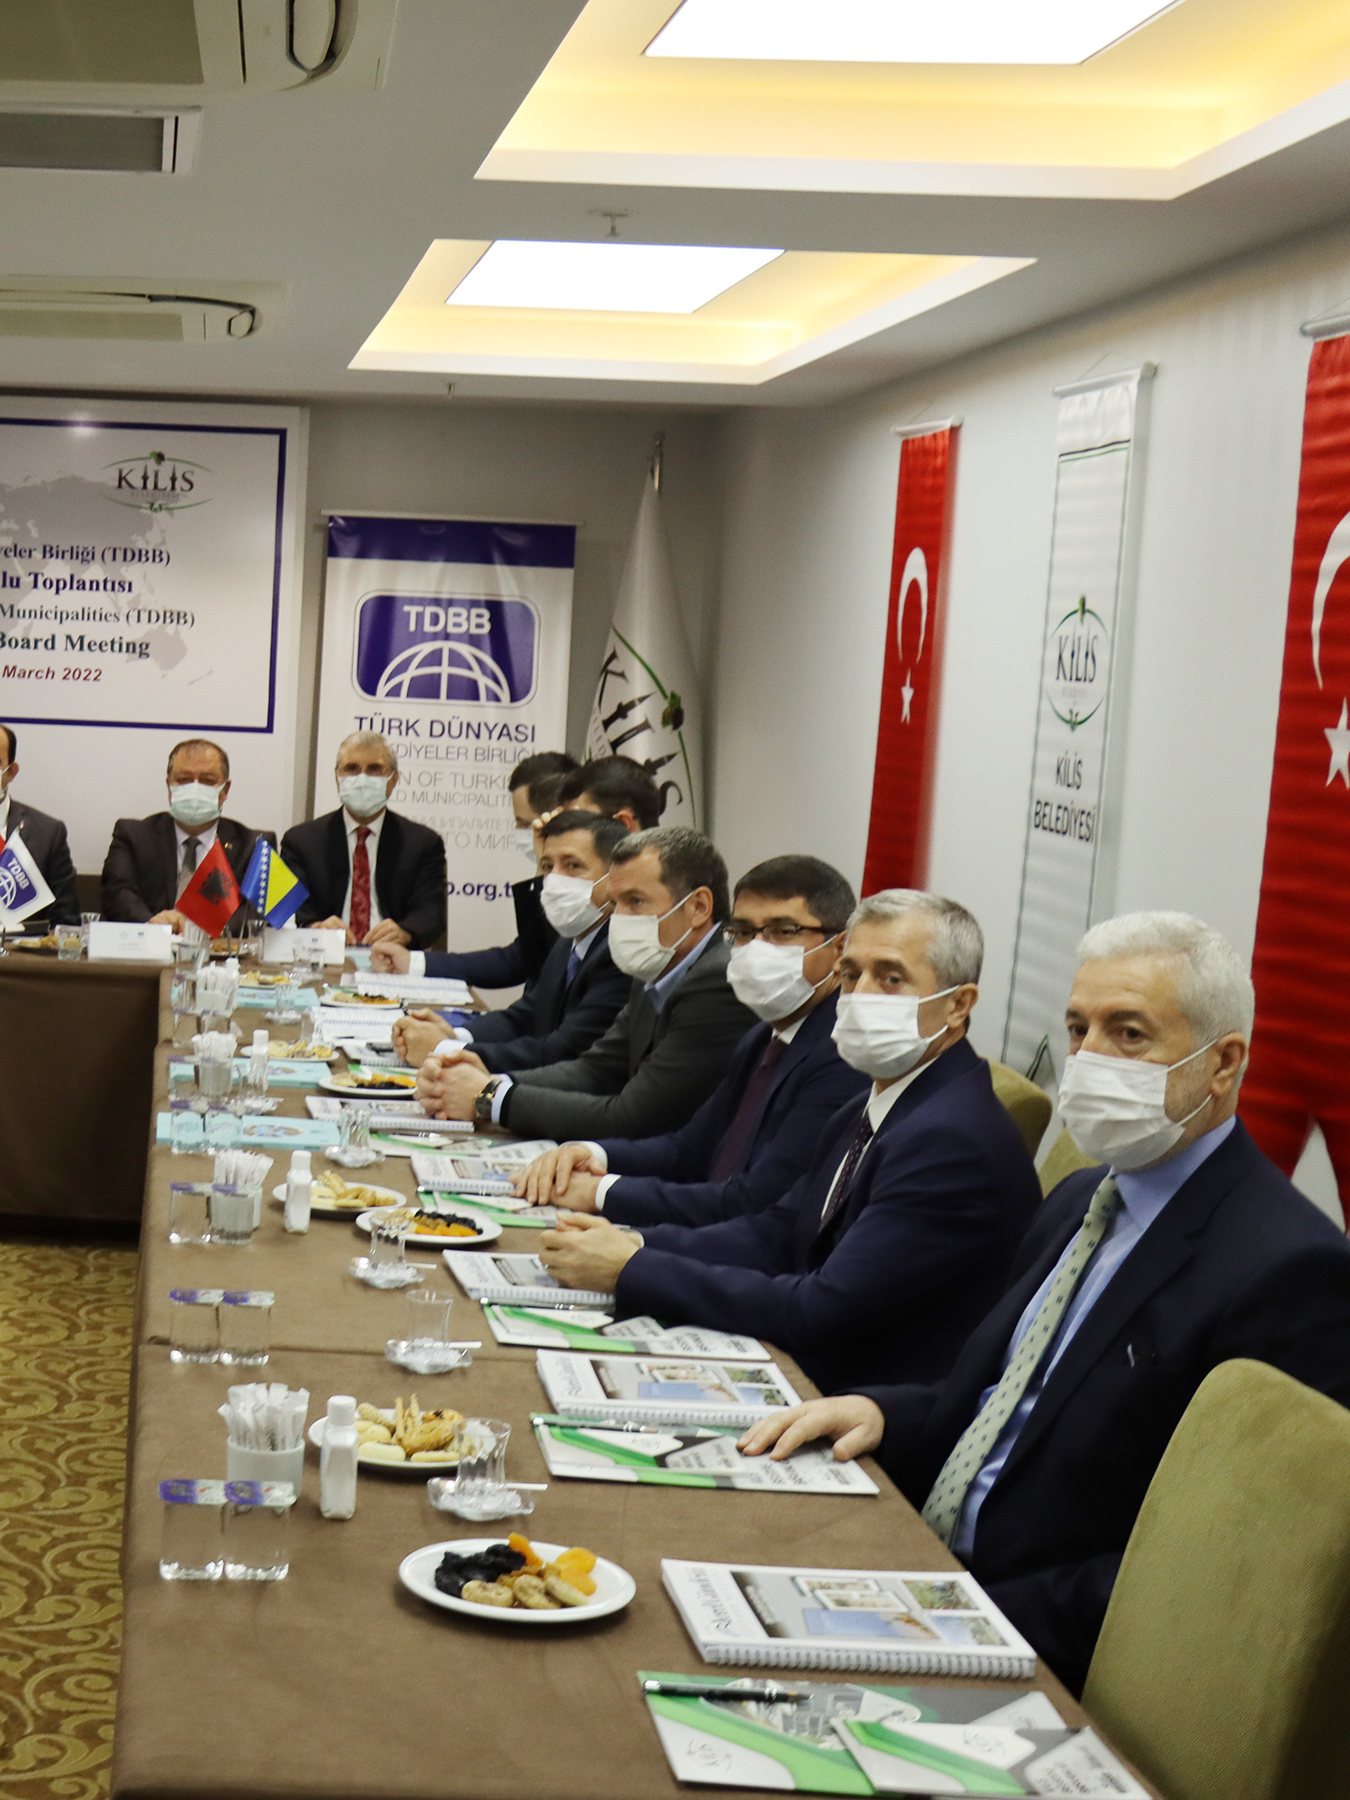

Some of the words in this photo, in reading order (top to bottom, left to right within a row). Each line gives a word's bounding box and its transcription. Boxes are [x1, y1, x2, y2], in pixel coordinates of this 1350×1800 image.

[42, 544, 96, 564] Birliği
[101, 546, 171, 567] (TDBB)
[28, 571, 134, 596] Toplantısı
[126, 608, 196, 629] (TDBB)
[403, 605, 492, 635] TDBB
[64, 634, 151, 659] Meeting
[2, 664, 56, 681] March
[62, 667, 103, 682] 2022
[354, 712, 421, 737] TÜRK
[429, 715, 536, 743] DÜNYASI
[394, 741, 468, 761] DİYELER
[418, 770, 444, 788] OF
[449, 771, 511, 791] TURKI
